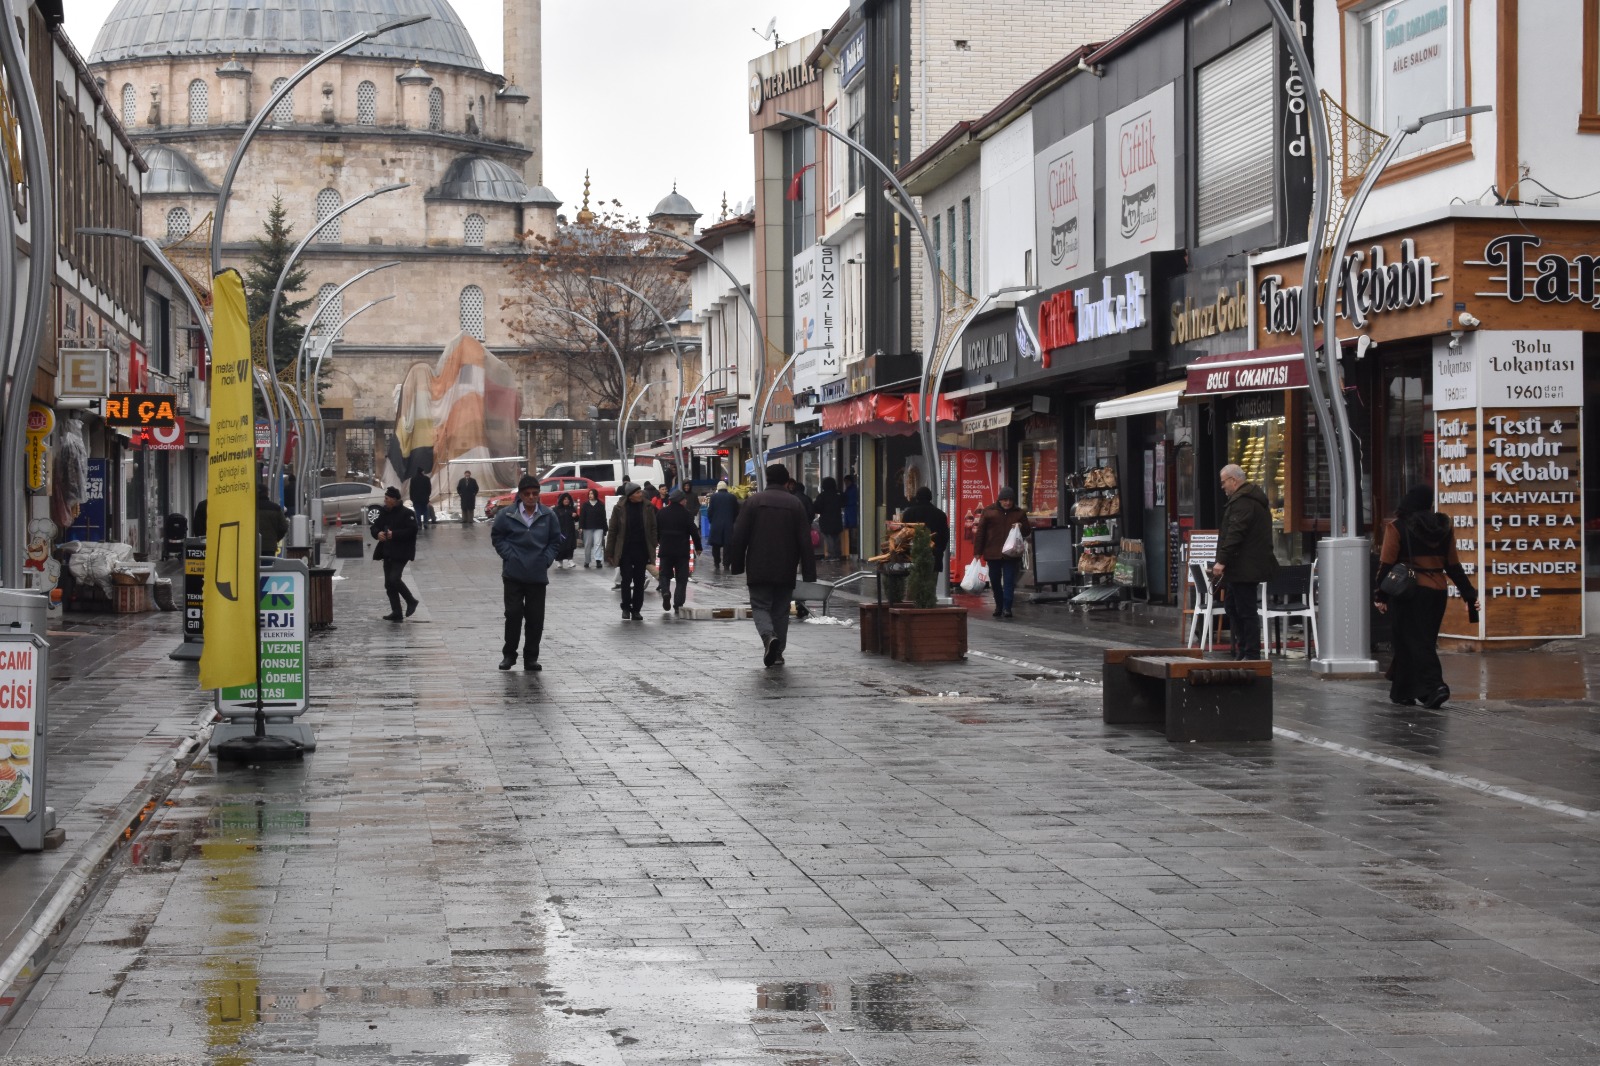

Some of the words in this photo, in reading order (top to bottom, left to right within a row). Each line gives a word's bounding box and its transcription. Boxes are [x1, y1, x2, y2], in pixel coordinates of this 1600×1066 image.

[1393, 56, 1408, 73] AİLE
[1410, 44, 1439, 66] SALONU
[1286, 75, 1306, 157] Gold
[1120, 118, 1157, 192] Çiftlik
[1049, 157, 1078, 223] Çiftlik
[822, 248, 835, 298] SOLMAZ
[1339, 238, 1432, 329] Kebabı
[1170, 296, 1216, 345] Solmaz
[1217, 279, 1248, 333] Gold
[967, 337, 989, 374] KOÇAK
[991, 332, 1009, 365] ALTIN
[1511, 339, 1551, 354] Bolu
[71, 359, 97, 388] E
[1438, 360, 1472, 377] Lokantası
[1489, 355, 1574, 375] Lokantası
[1206, 371, 1229, 390] BOLU
[1235, 366, 1288, 388] LOKANTASI
[1506, 385, 1542, 399] 1960
[106, 397, 129, 418] Rİ
[138, 401, 175, 424] ÇA
[28, 414, 48, 428] ALE
[964, 420, 982, 433] KOÇAK
[982, 417, 998, 429] ALTIN
[1438, 418, 1460, 436] Testi
[1460, 421, 1468, 436] &
[1489, 415, 1541, 435] Testi
[1549, 419, 1563, 434] &
[149, 442, 185, 451] vodafone
[1438, 438, 1468, 459] Tandır
[1489, 437, 1562, 460] Tandır
[1439, 463, 1471, 486] Kebabı
[1490, 461, 1569, 485] Kebabı
[1439, 491, 1474, 504] KAHVALTI
[1491, 491, 1574, 504] KAHVALTI
[1453, 515, 1474, 528] RBA
[1491, 514, 1575, 532] ÇORBA
[1492, 538, 1576, 551] IZGARA
[1492, 558, 1577, 575] İSKENDER
[1492, 582, 1541, 599] PİDE
[187, 621, 200, 629] GM
[263, 630, 295, 638] ELEKTRİK
[0, 646, 32, 670] CAMİ
[267, 644, 301, 654] VEZNE
[265, 671, 302, 683] ÖDEME
[0, 679, 32, 709] CİSİ
[239, 688, 285, 699] NOTASI
